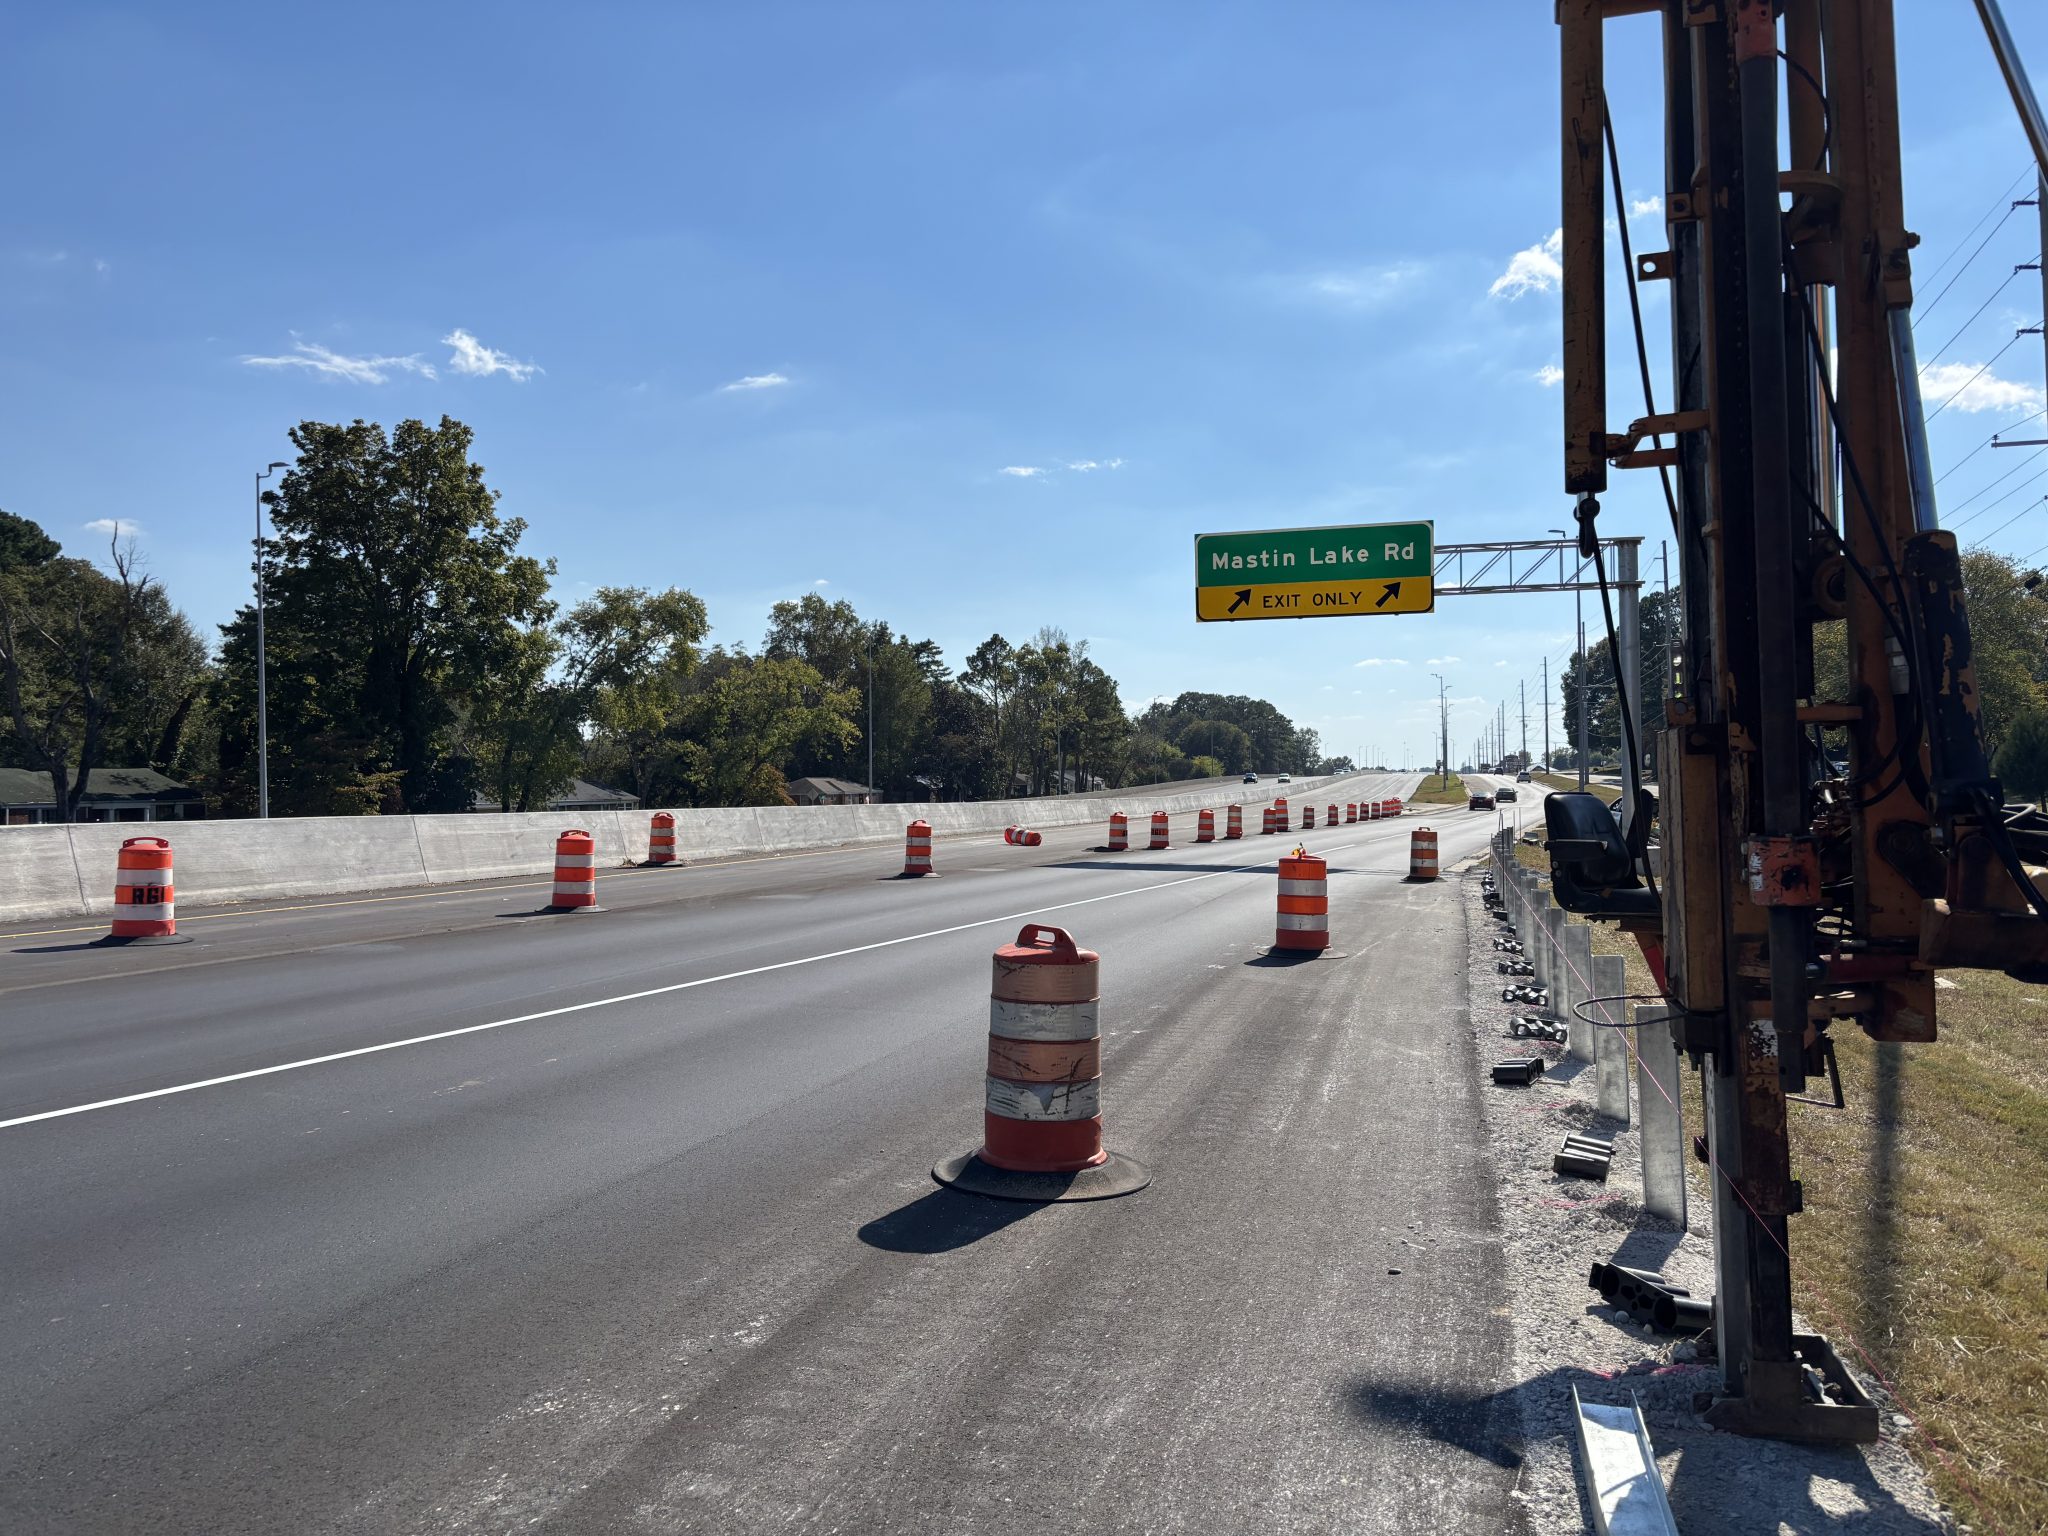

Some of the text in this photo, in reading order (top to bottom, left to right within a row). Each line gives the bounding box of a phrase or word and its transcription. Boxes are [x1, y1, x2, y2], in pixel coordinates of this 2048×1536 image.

[1212, 542, 1414, 570] Mastin Lake Rd
[1263, 591, 1362, 608] EXIT ONLY
